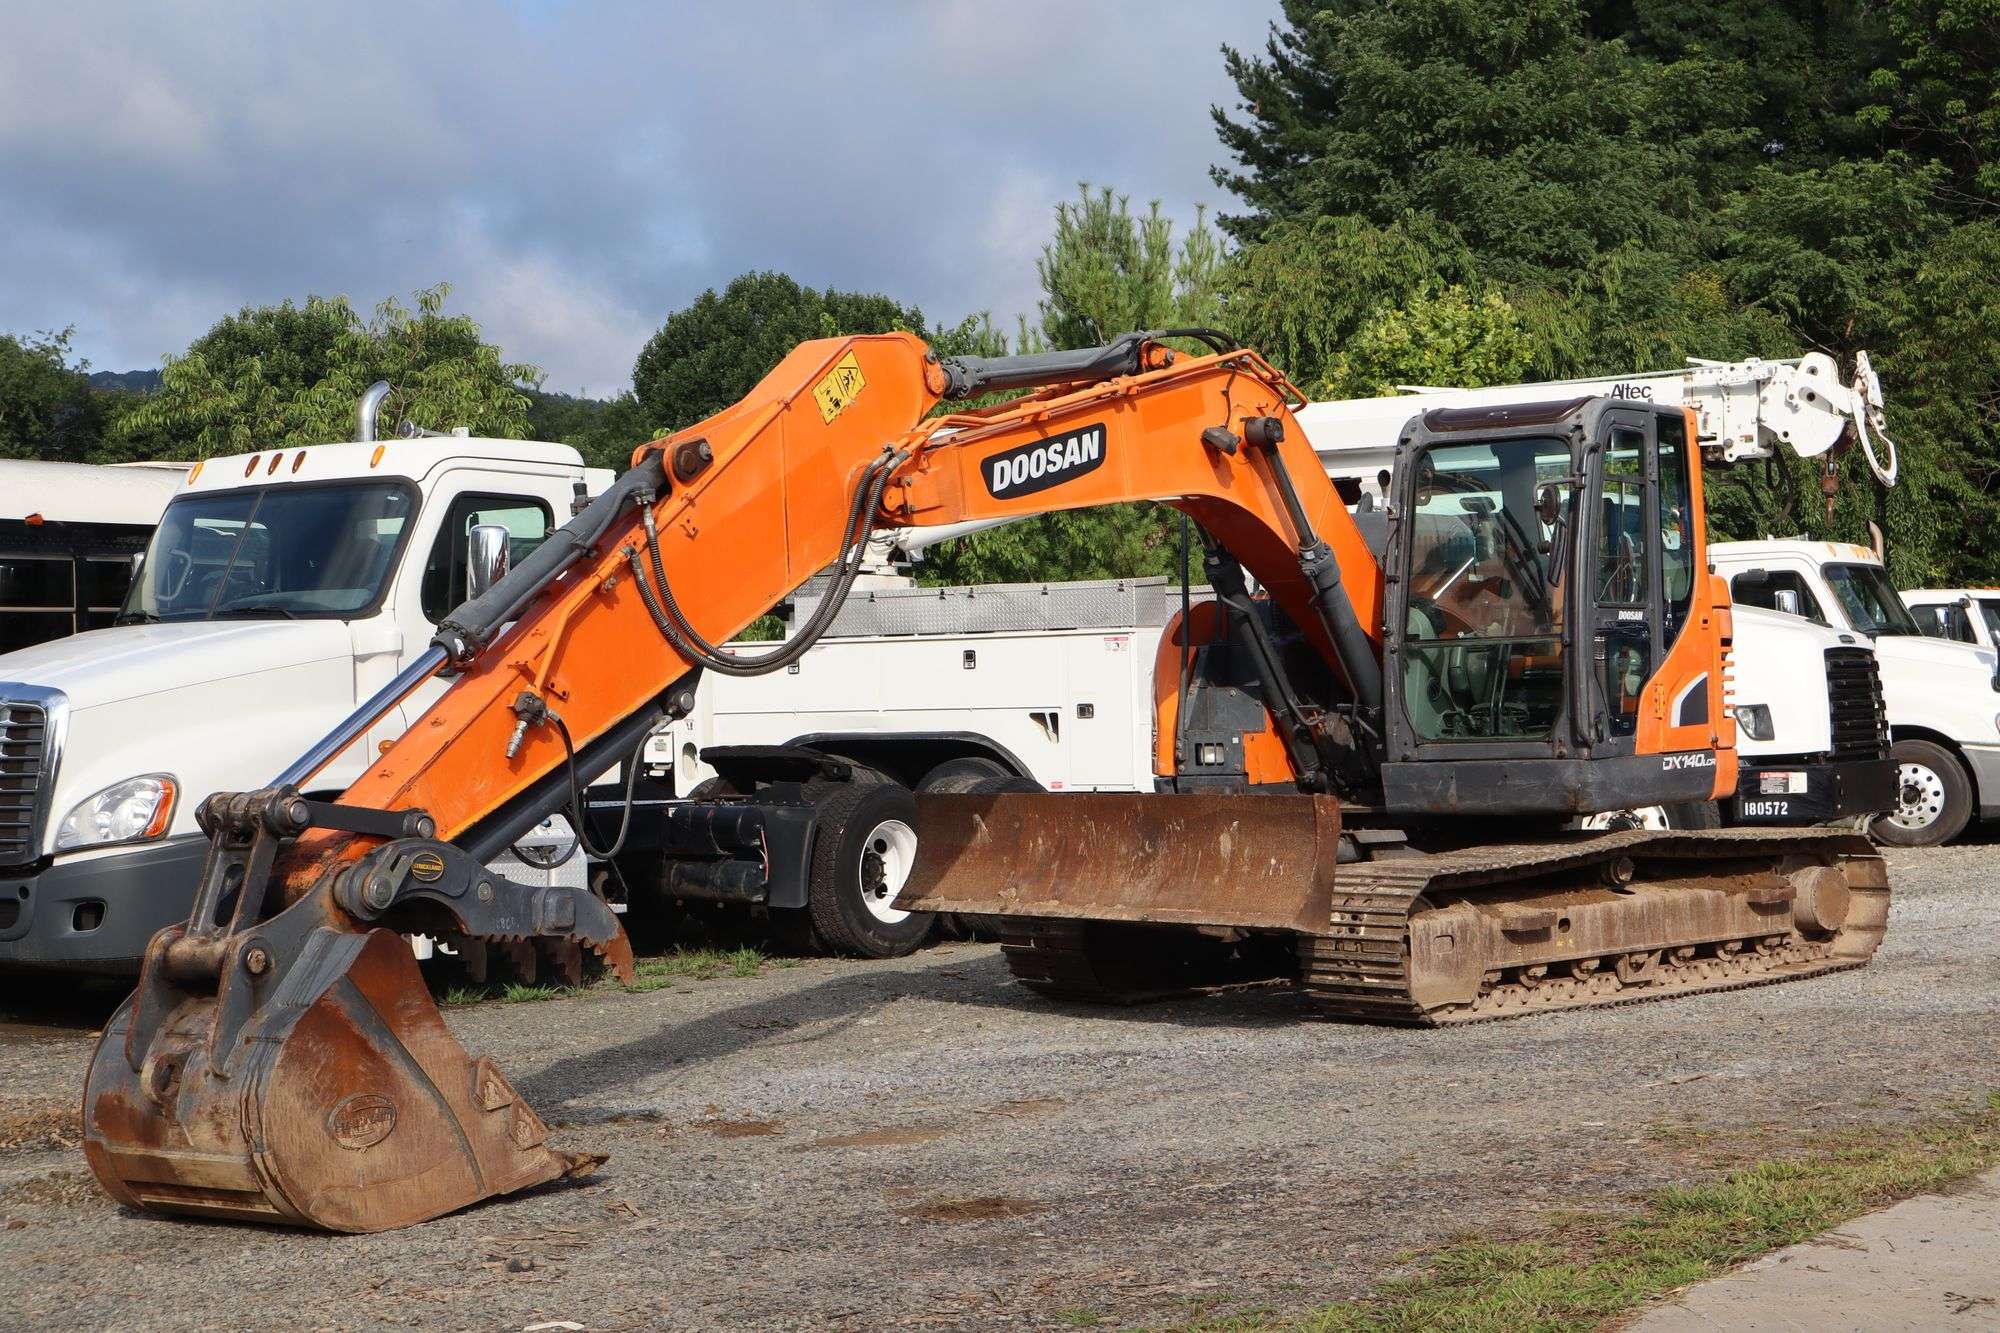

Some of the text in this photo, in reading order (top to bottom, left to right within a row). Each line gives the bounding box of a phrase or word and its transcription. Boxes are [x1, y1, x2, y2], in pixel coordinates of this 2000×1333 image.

[1611, 383, 1652, 400] Altec
[992, 430, 1100, 493] DOOSAN
[1618, 610, 1643, 620] DOOSAN
